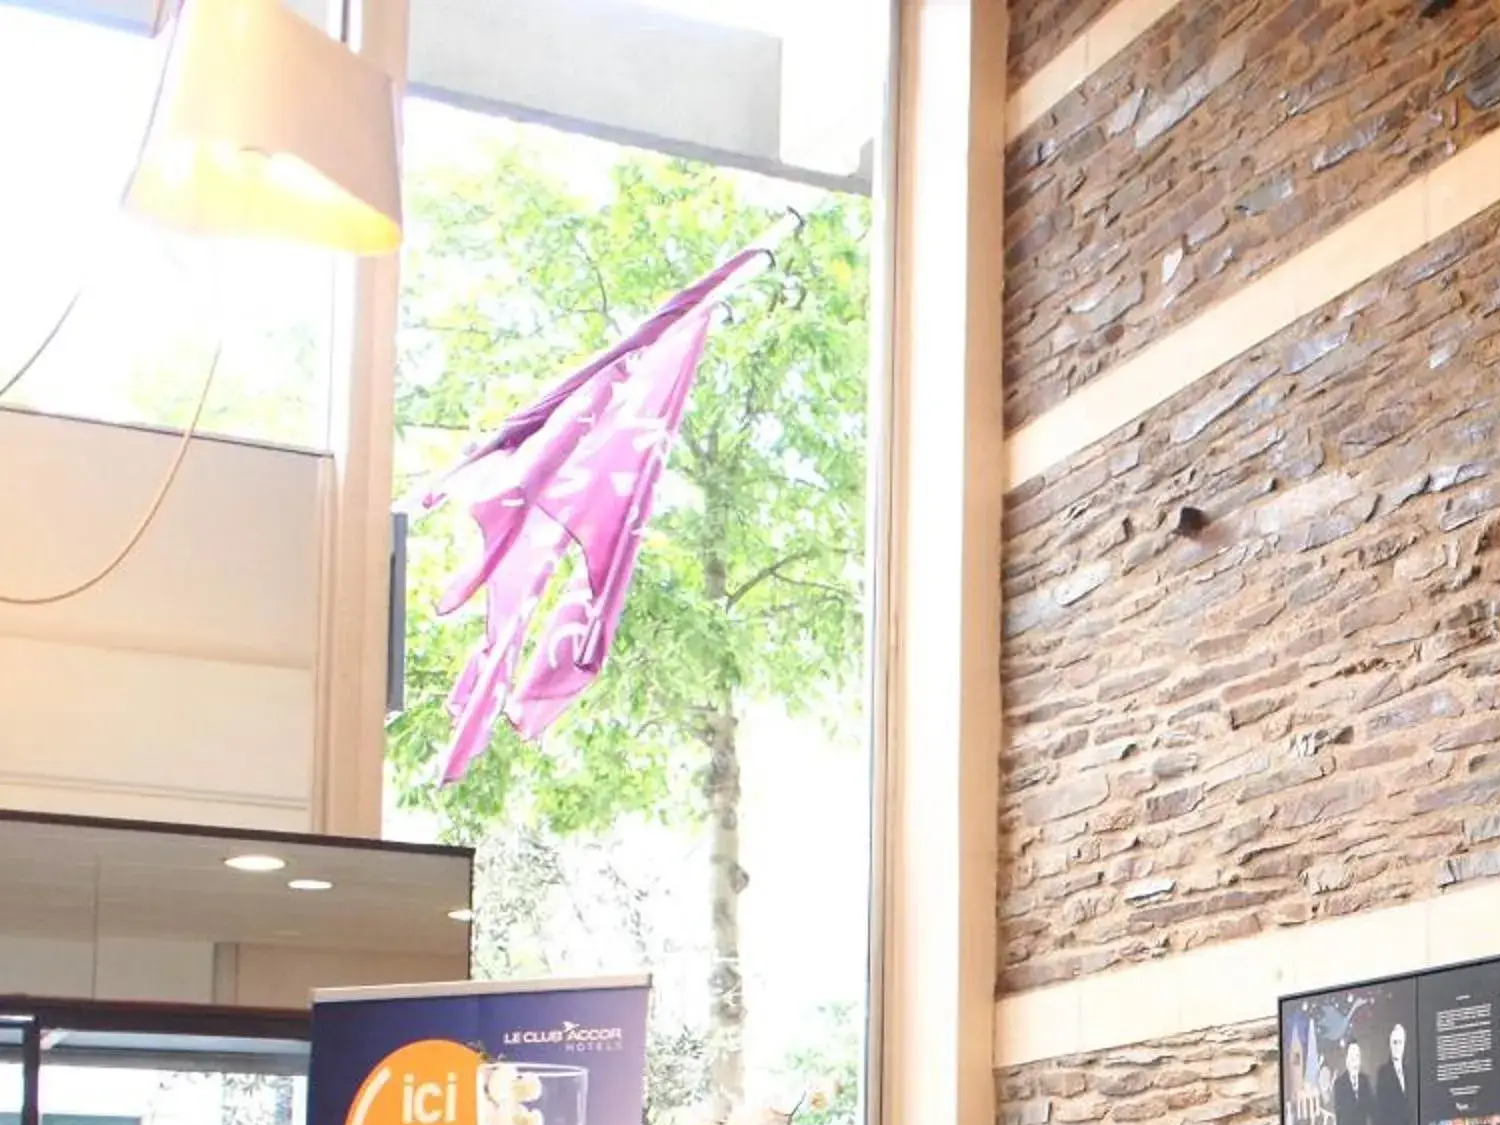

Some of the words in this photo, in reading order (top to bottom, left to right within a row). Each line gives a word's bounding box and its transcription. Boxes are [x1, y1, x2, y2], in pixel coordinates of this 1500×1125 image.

[504, 1032, 520, 1044] LE
[523, 1030, 562, 1044] CLUB
[402, 1072, 457, 1125] ici
